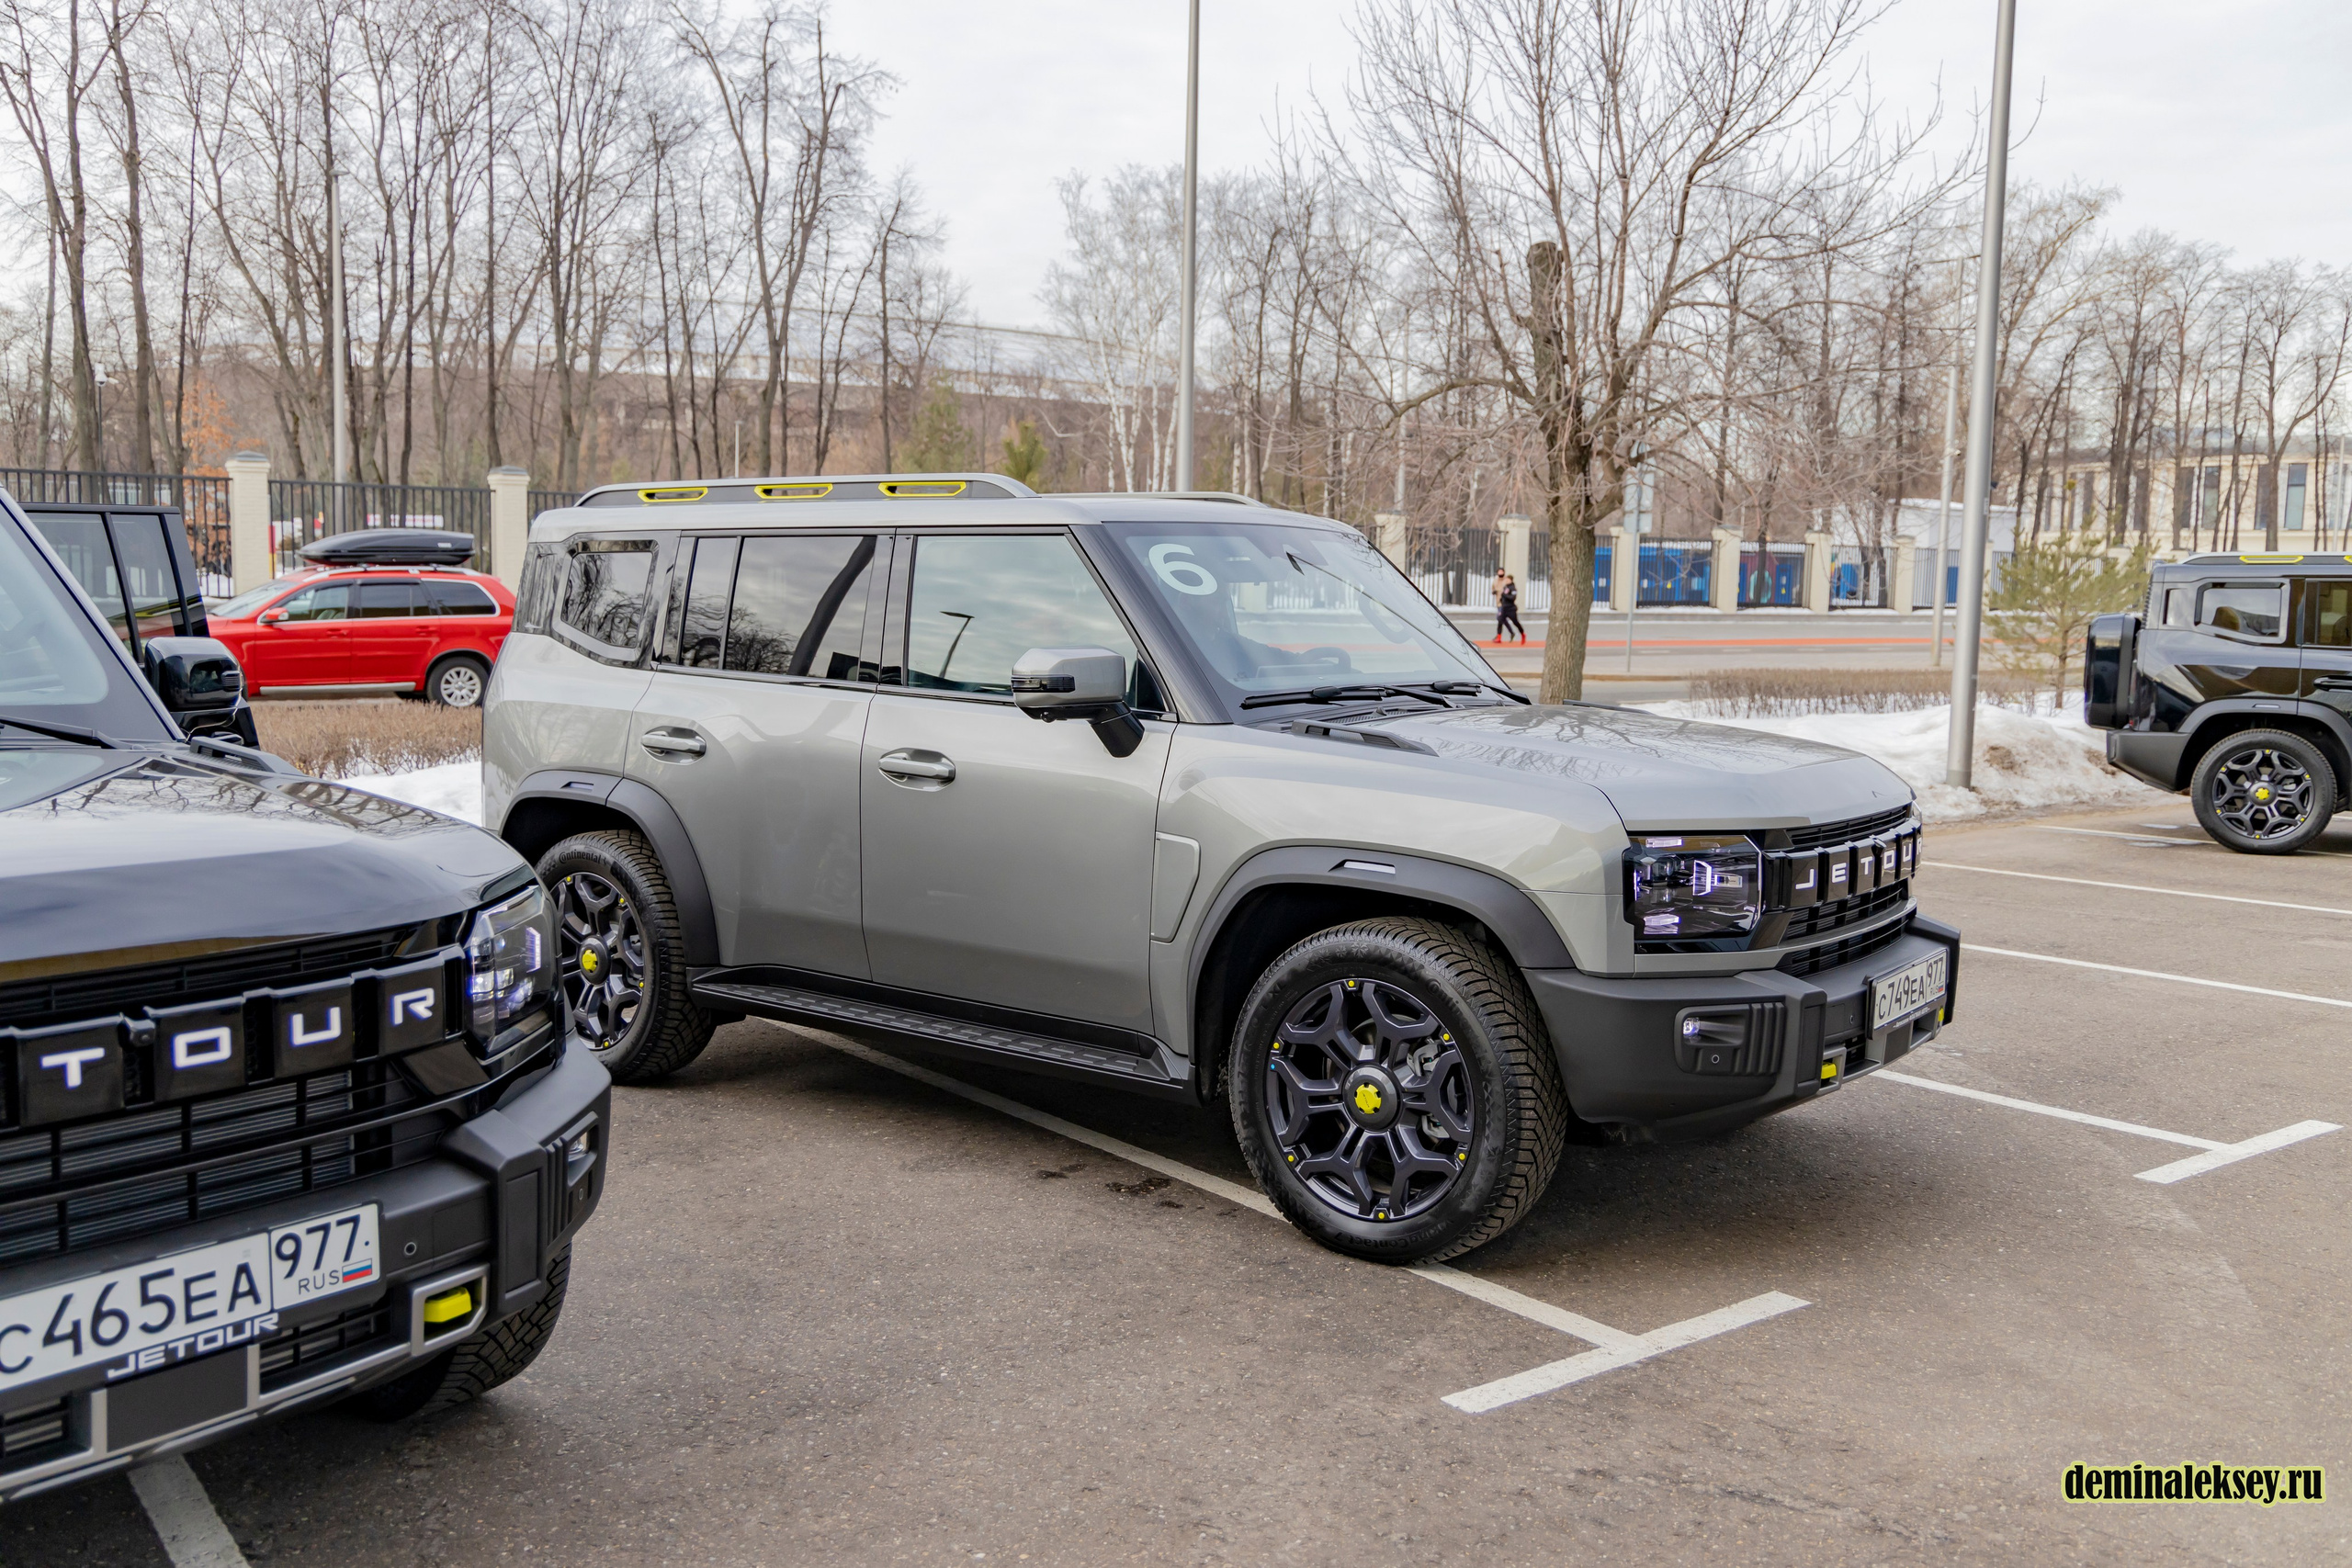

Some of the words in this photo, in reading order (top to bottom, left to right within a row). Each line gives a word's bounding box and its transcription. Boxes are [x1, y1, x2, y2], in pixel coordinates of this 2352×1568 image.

[1148, 543, 1218, 595] 6
[1795, 837, 1922, 890] JETOUR
[1928, 956, 1944, 987] 977
[275, 1214, 361, 1280] 977
[298, 1269, 340, 1295] RUS
[107, 1313, 279, 1379] JETOUR
